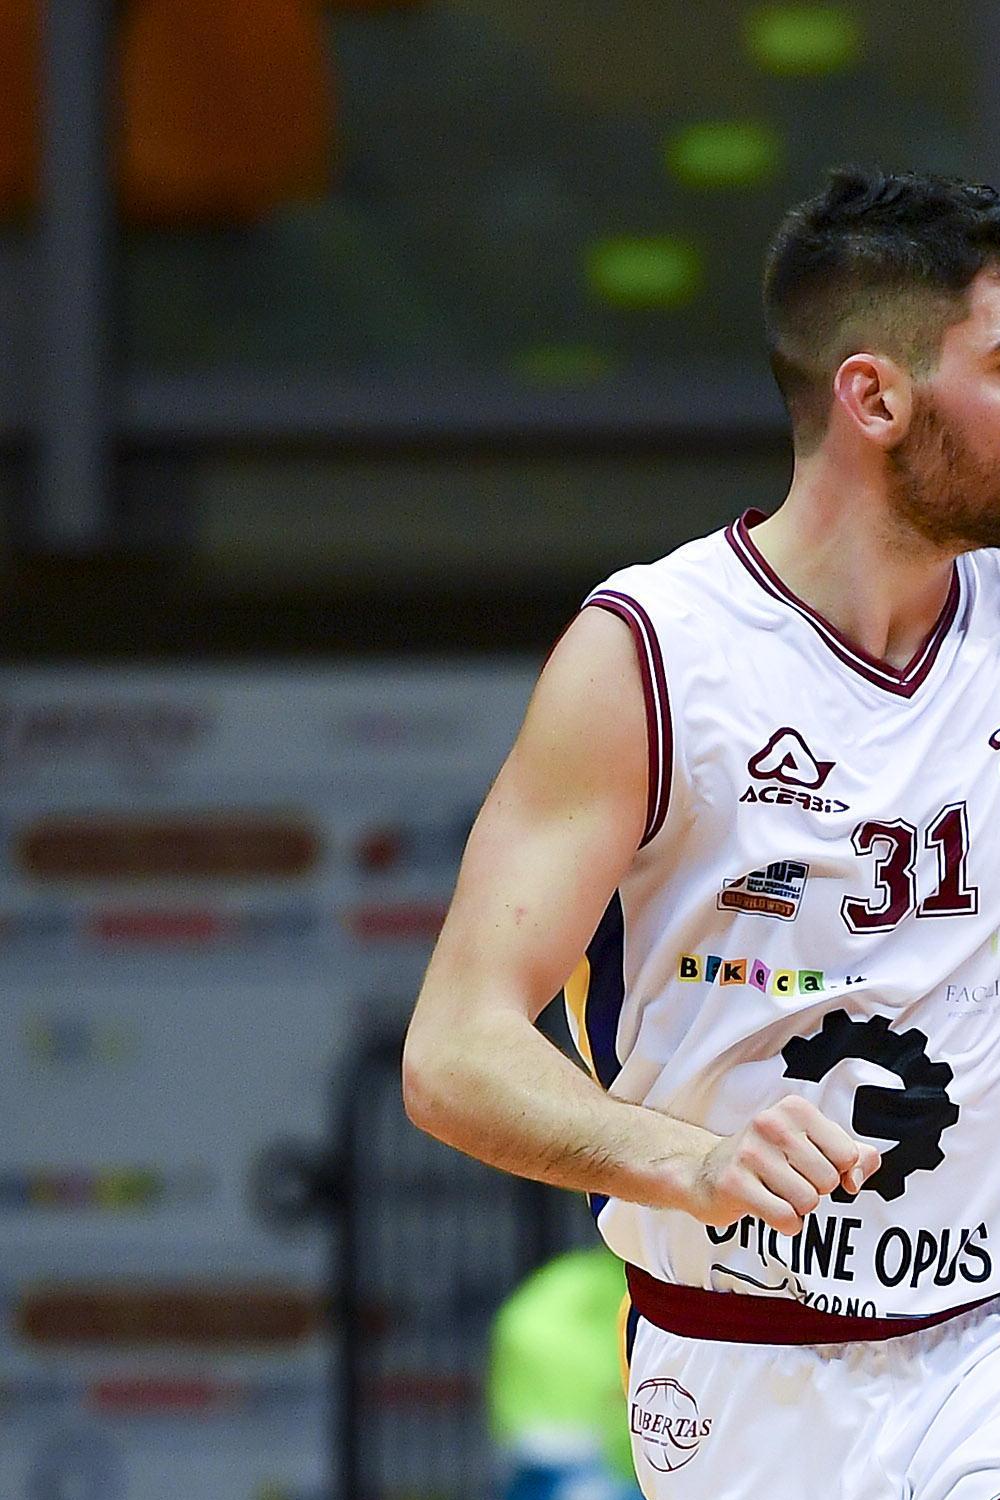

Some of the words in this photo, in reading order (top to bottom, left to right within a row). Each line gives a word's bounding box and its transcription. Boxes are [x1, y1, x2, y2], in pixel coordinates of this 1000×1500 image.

[840, 800, 978, 934] 31
[875, 1222, 992, 1288] OPUS
[631, 1403, 712, 1447] LIBERTAS
